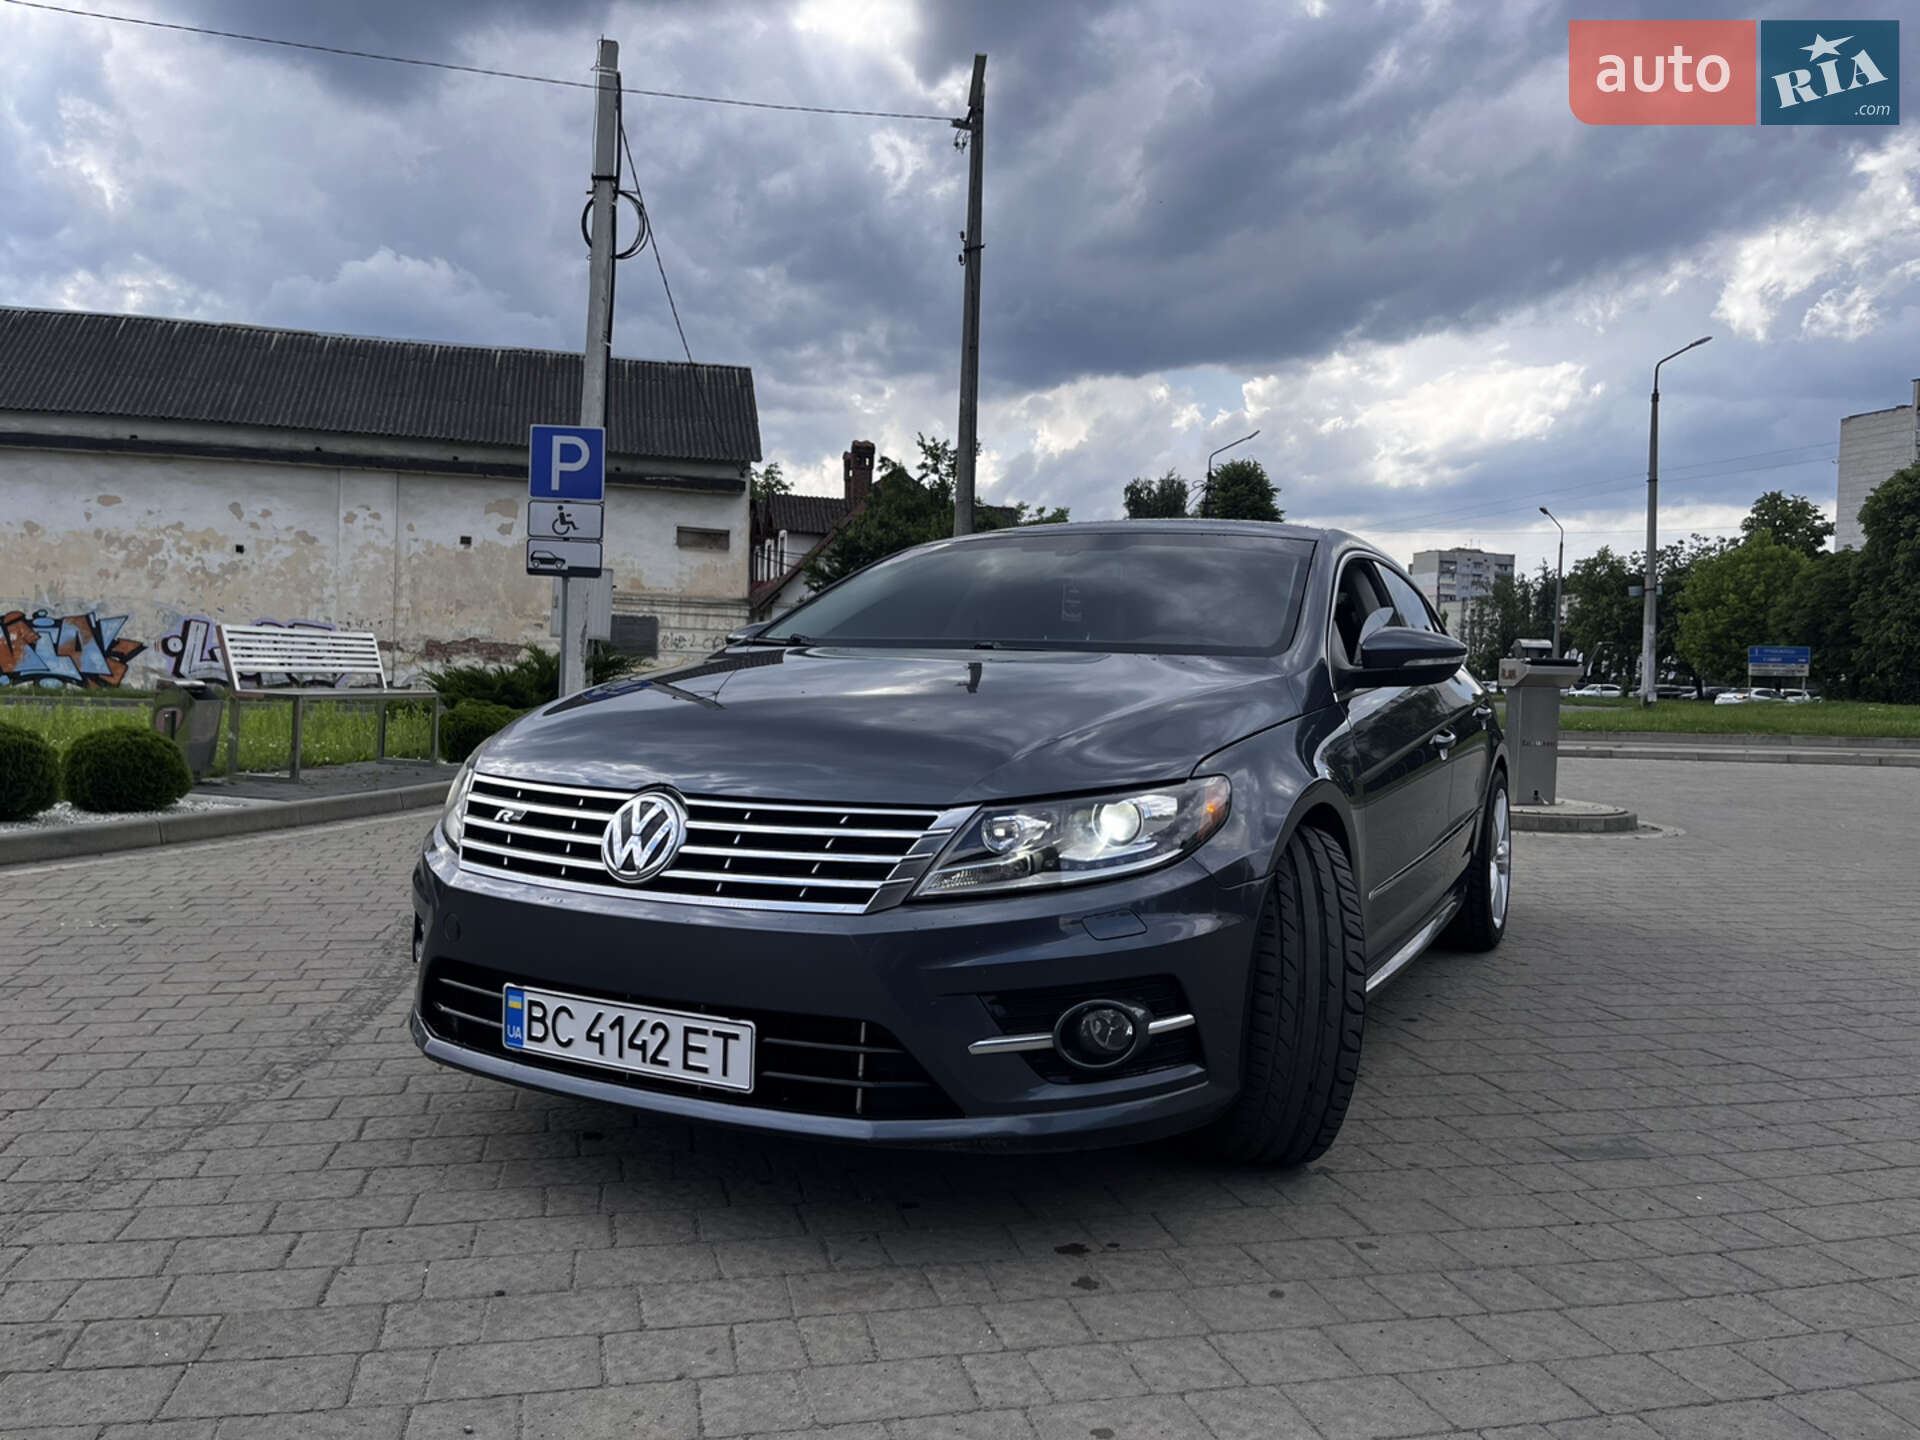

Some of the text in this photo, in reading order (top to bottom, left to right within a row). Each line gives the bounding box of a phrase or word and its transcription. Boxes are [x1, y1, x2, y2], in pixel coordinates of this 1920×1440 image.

[550, 434, 591, 491] P
[507, 1024, 522, 1040] UA
[527, 999, 741, 1077] BC 4142 ET
